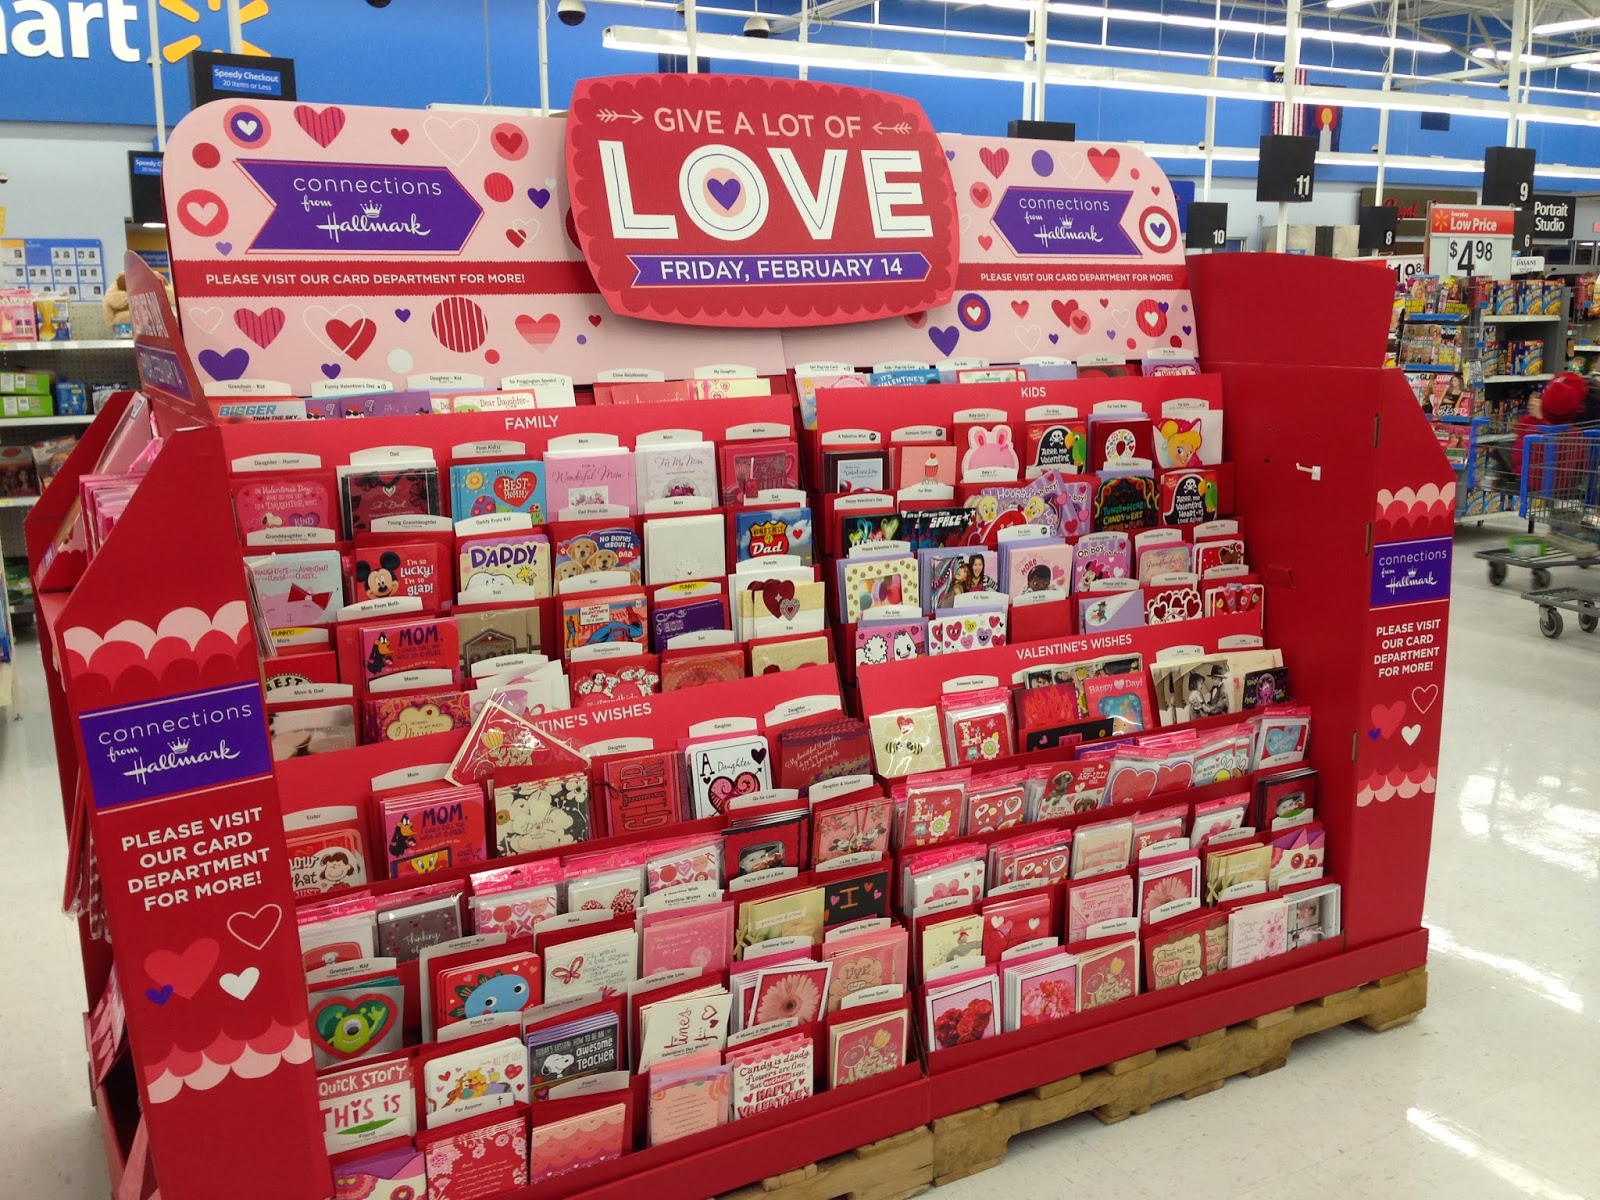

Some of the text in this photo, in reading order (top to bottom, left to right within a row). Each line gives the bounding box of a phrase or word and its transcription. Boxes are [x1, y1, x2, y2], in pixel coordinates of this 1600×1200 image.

[0, 0, 140, 62] art
[214, 69, 278, 83] Speedy Checkout
[232, 80, 249, 89] Items
[258, 83, 272, 91] Less
[654, 107, 861, 139] GIVE A LOT OF
[135, 159, 155, 167] Speedy
[294, 177, 442, 196] connections
[598, 140, 934, 241] LOVE
[1296, 174, 1311, 196] 11
[1520, 183, 1528, 201] 9
[301, 195, 332, 212] from
[1019, 197, 1110, 212] connections
[1534, 202, 1568, 217] Portrait
[1024, 212, 1043, 224] from
[1450, 218, 1497, 231] Low Price
[1535, 217, 1565, 232] Studio
[316, 212, 431, 243] Hallmark
[1034, 224, 1103, 248] Hallmark
[1213, 230, 1225, 244] 10
[1385, 231, 1393, 245] 8
[1524, 234, 1530, 247] 6
[660, 257, 903, 283] FRIDAY, FEBRUARY 14
[981, 273, 1173, 281] PLEASE VISIT OUR CARD DEPARTMENT FOR MORE!
[205, 273, 525, 286] PLEASE VISIT OUR CARD DEPARTMENT FOR MORE!
[878, 376, 924, 387] VALENTINE'S
[1021, 387, 1046, 398] KIDS
[218, 405, 277, 416] BIGGER
[505, 415, 558, 430] FAMILY
[502, 477, 528, 490] BEST
[552, 470, 596, 487] Wonderful
[504, 490, 530, 500] MOMMY
[293, 518, 314, 526] KIND
[929, 516, 963, 528] SPACE
[753, 527, 771, 536] WORLD'S
[751, 541, 783, 555] Dad
[470, 545, 537, 569] DADDY,
[1379, 549, 1447, 566] connections
[1381, 567, 1395, 578] from
[1385, 572, 1438, 595] Hallmark
[1376, 619, 1441, 636] PLEASE VISIT
[1017, 634, 1132, 660] VALENTINE'S WISHES
[1382, 634, 1433, 649] OUR CARD
[496, 659, 524, 667] Grandmother
[1374, 647, 1440, 664] DEPARTMENT
[1379, 661, 1433, 678] FOR MORE!
[266, 678, 303, 691] BEST
[1088, 678, 1143, 694] Happy Day!
[98, 703, 252, 745] connections
[534, 702, 652, 733] TINE'S WISHES
[107, 747, 139, 762] from
[123, 739, 241, 785] Hallmark
[700, 753, 751, 777] A Daughter
[121, 807, 262, 852] PLEASE VISIT
[140, 831, 252, 869] OUR CARD
[127, 847, 270, 893] DEPARTMENT
[144, 871, 262, 911] FOR MORE!
[403, 932, 441, 945] Thinking
[329, 965, 354, 974] Grandson
[645, 976, 666, 984] Celebrate
[858, 989, 889, 1000] Someone Special
[576, 1037, 613, 1057] awesome
[577, 1049, 614, 1070] TEACHER
[756, 1080, 797, 1101] HAPPY
[464, 1102, 482, 1111] Anyone
[737, 1087, 811, 1118] VALENTINE'S
[359, 1131, 376, 1139] Friend
